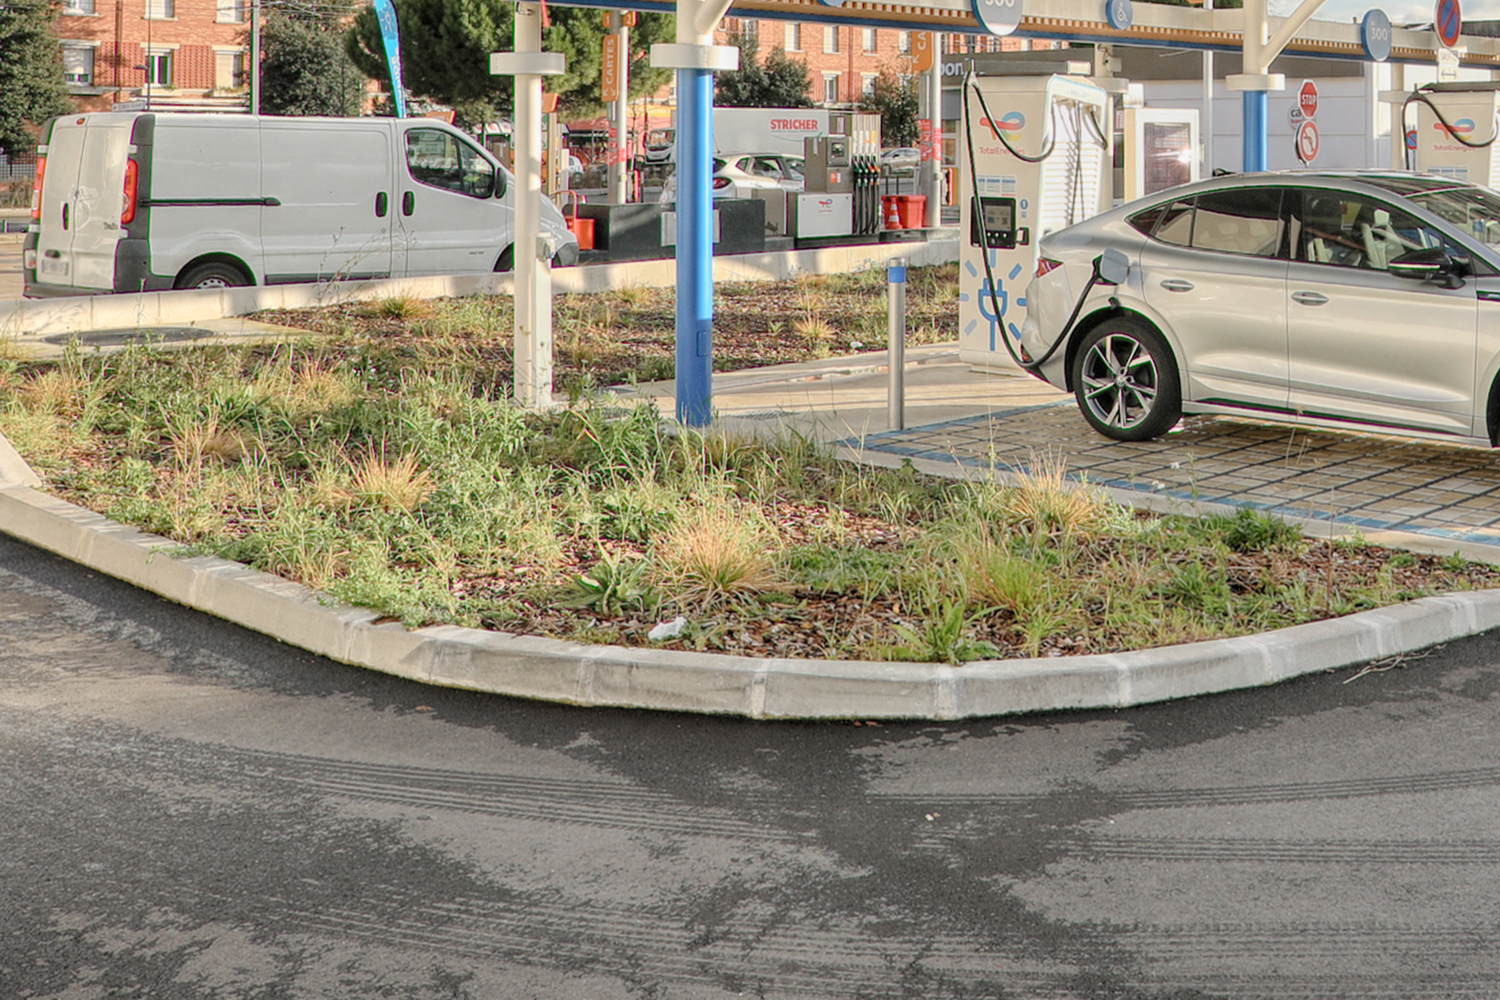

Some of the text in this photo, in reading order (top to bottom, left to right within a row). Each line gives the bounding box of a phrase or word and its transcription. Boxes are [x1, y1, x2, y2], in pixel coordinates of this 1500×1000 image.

[1370, 26, 1389, 41] 300
[606, 39, 615, 85] CARTES
[1301, 93, 1317, 106] STOP
[770, 118, 818, 131] STRICHER
